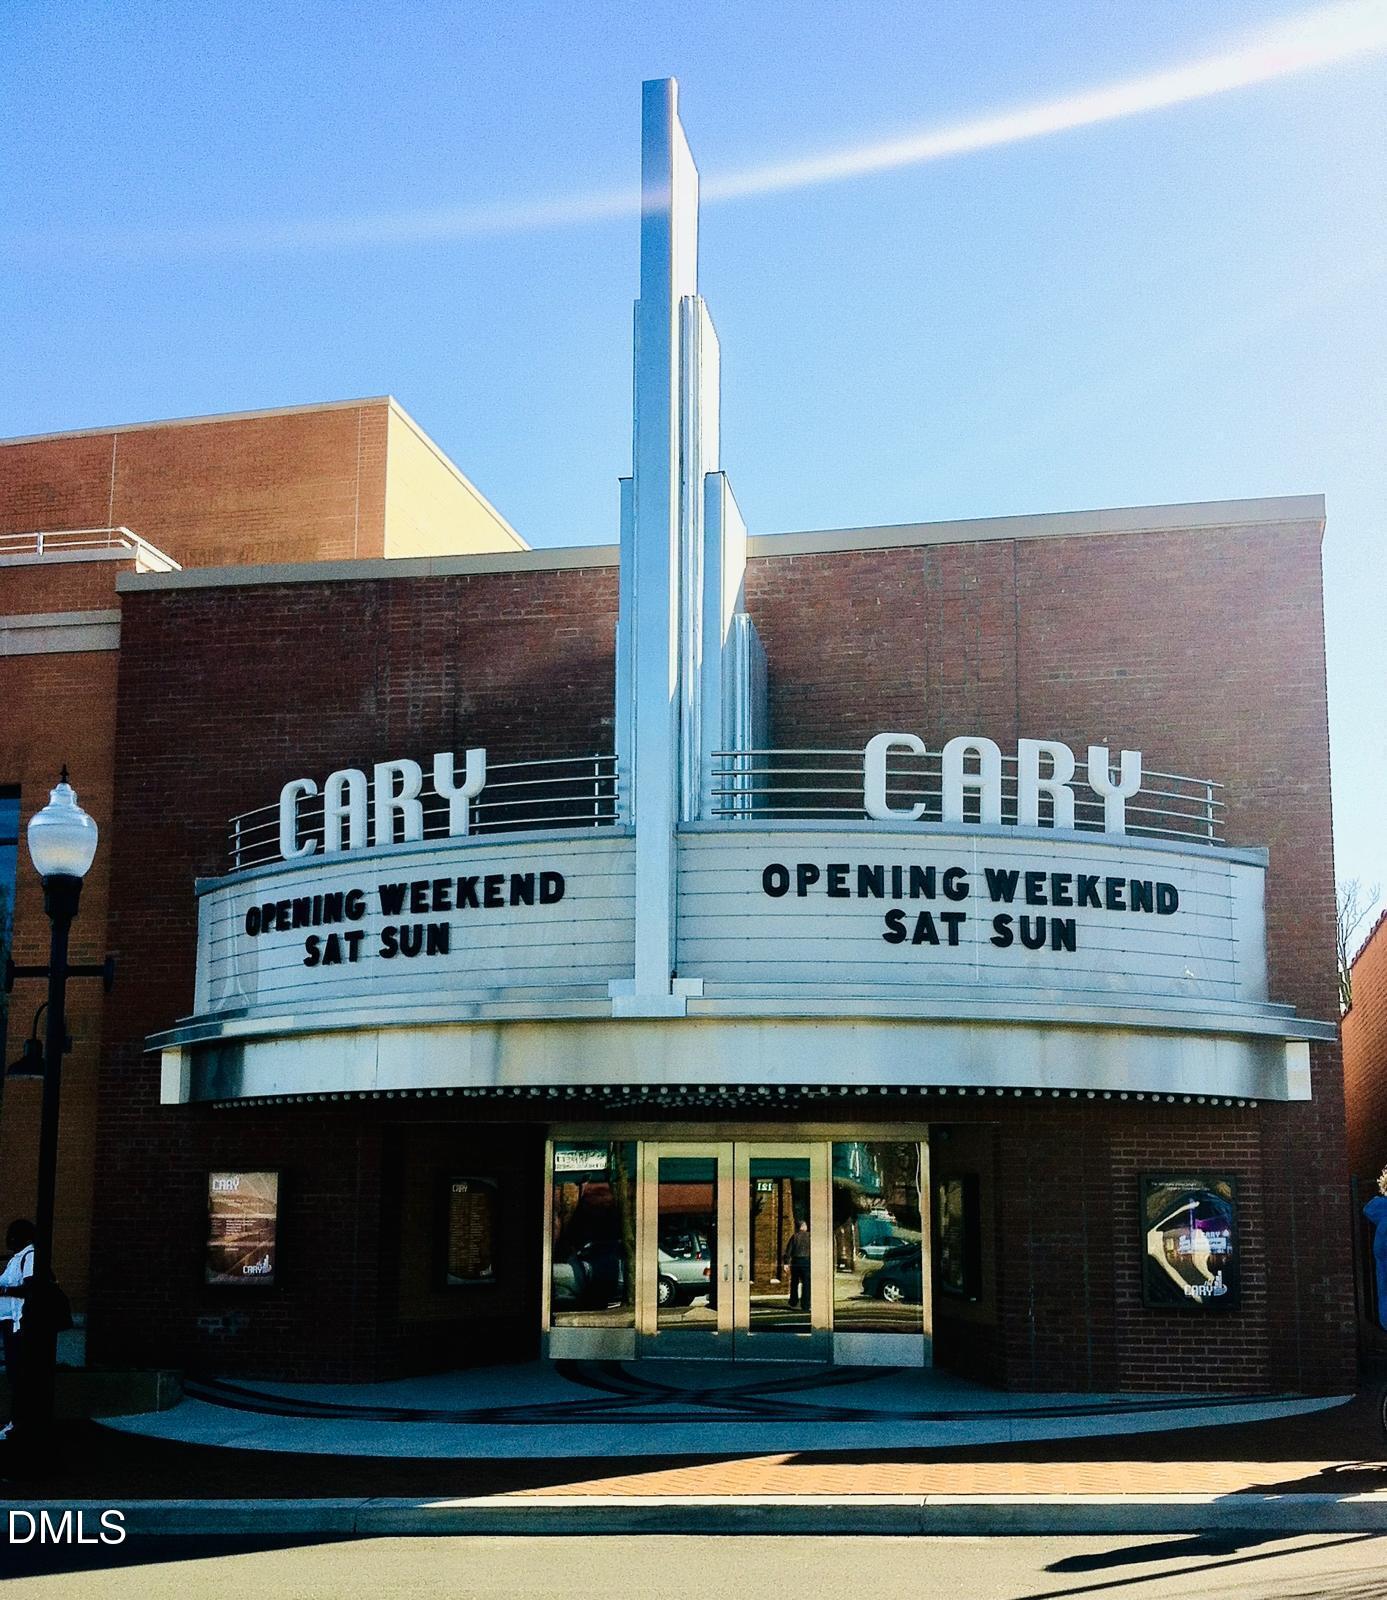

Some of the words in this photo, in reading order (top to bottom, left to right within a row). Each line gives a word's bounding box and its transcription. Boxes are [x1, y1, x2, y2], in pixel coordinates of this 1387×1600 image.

[279, 748, 487, 860] CARY
[864, 732, 1142, 835] CARY
[245, 888, 366, 937] OPENING
[378, 870, 566, 916] WEEKEND
[762, 863, 970, 901] OPENING
[984, 867, 1180, 916] WEEKEND
[303, 930, 364, 968] SAT
[378, 922, 451, 960] SUN
[882, 909, 967, 946] SAT
[989, 914, 1078, 952] SUN
[212, 1178, 240, 1190] CARY
[243, 1265, 262, 1274] CARY
[1184, 1284, 1214, 1296] CARY
